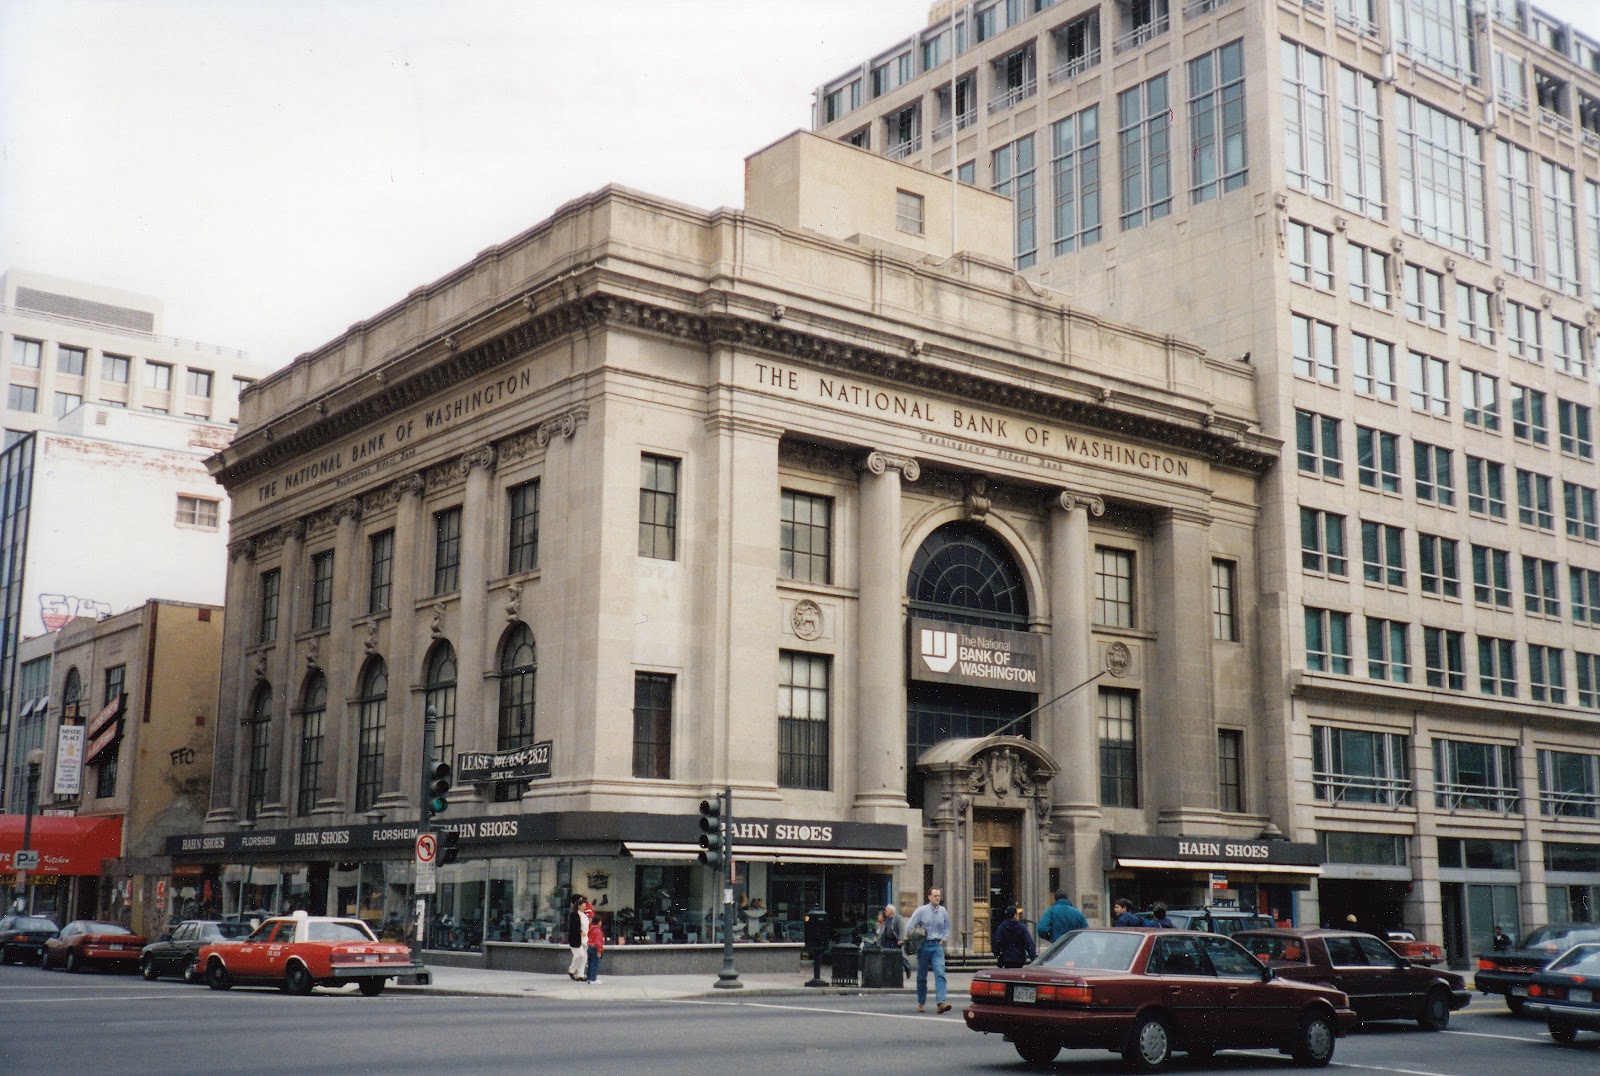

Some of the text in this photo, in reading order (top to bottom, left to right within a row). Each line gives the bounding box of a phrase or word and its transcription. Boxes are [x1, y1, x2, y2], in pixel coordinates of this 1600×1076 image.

[755, 363, 1189, 477] THE NATIONAL BANK OF WASHINGTON
[258, 368, 531, 502] THE NATIONAL BANK OF WASHINGTON
[960, 634, 1011, 651] The National
[960, 647, 1011, 666] BANK OF
[960, 661, 1036, 683] WASHINGTON
[461, 755, 489, 771] LEASE
[372, 828, 418, 841] FLORSHEIM
[480, 821, 518, 837] SHOES
[775, 824, 832, 841] SHOES
[182, 837, 225, 850] HAHN SHOES
[241, 836, 276, 847] FLORSHEIM
[293, 831, 349, 845] HAHN SHOES
[1179, 842, 1269, 858] HAHN SHOES
[43, 854, 70, 864] Kitchen
